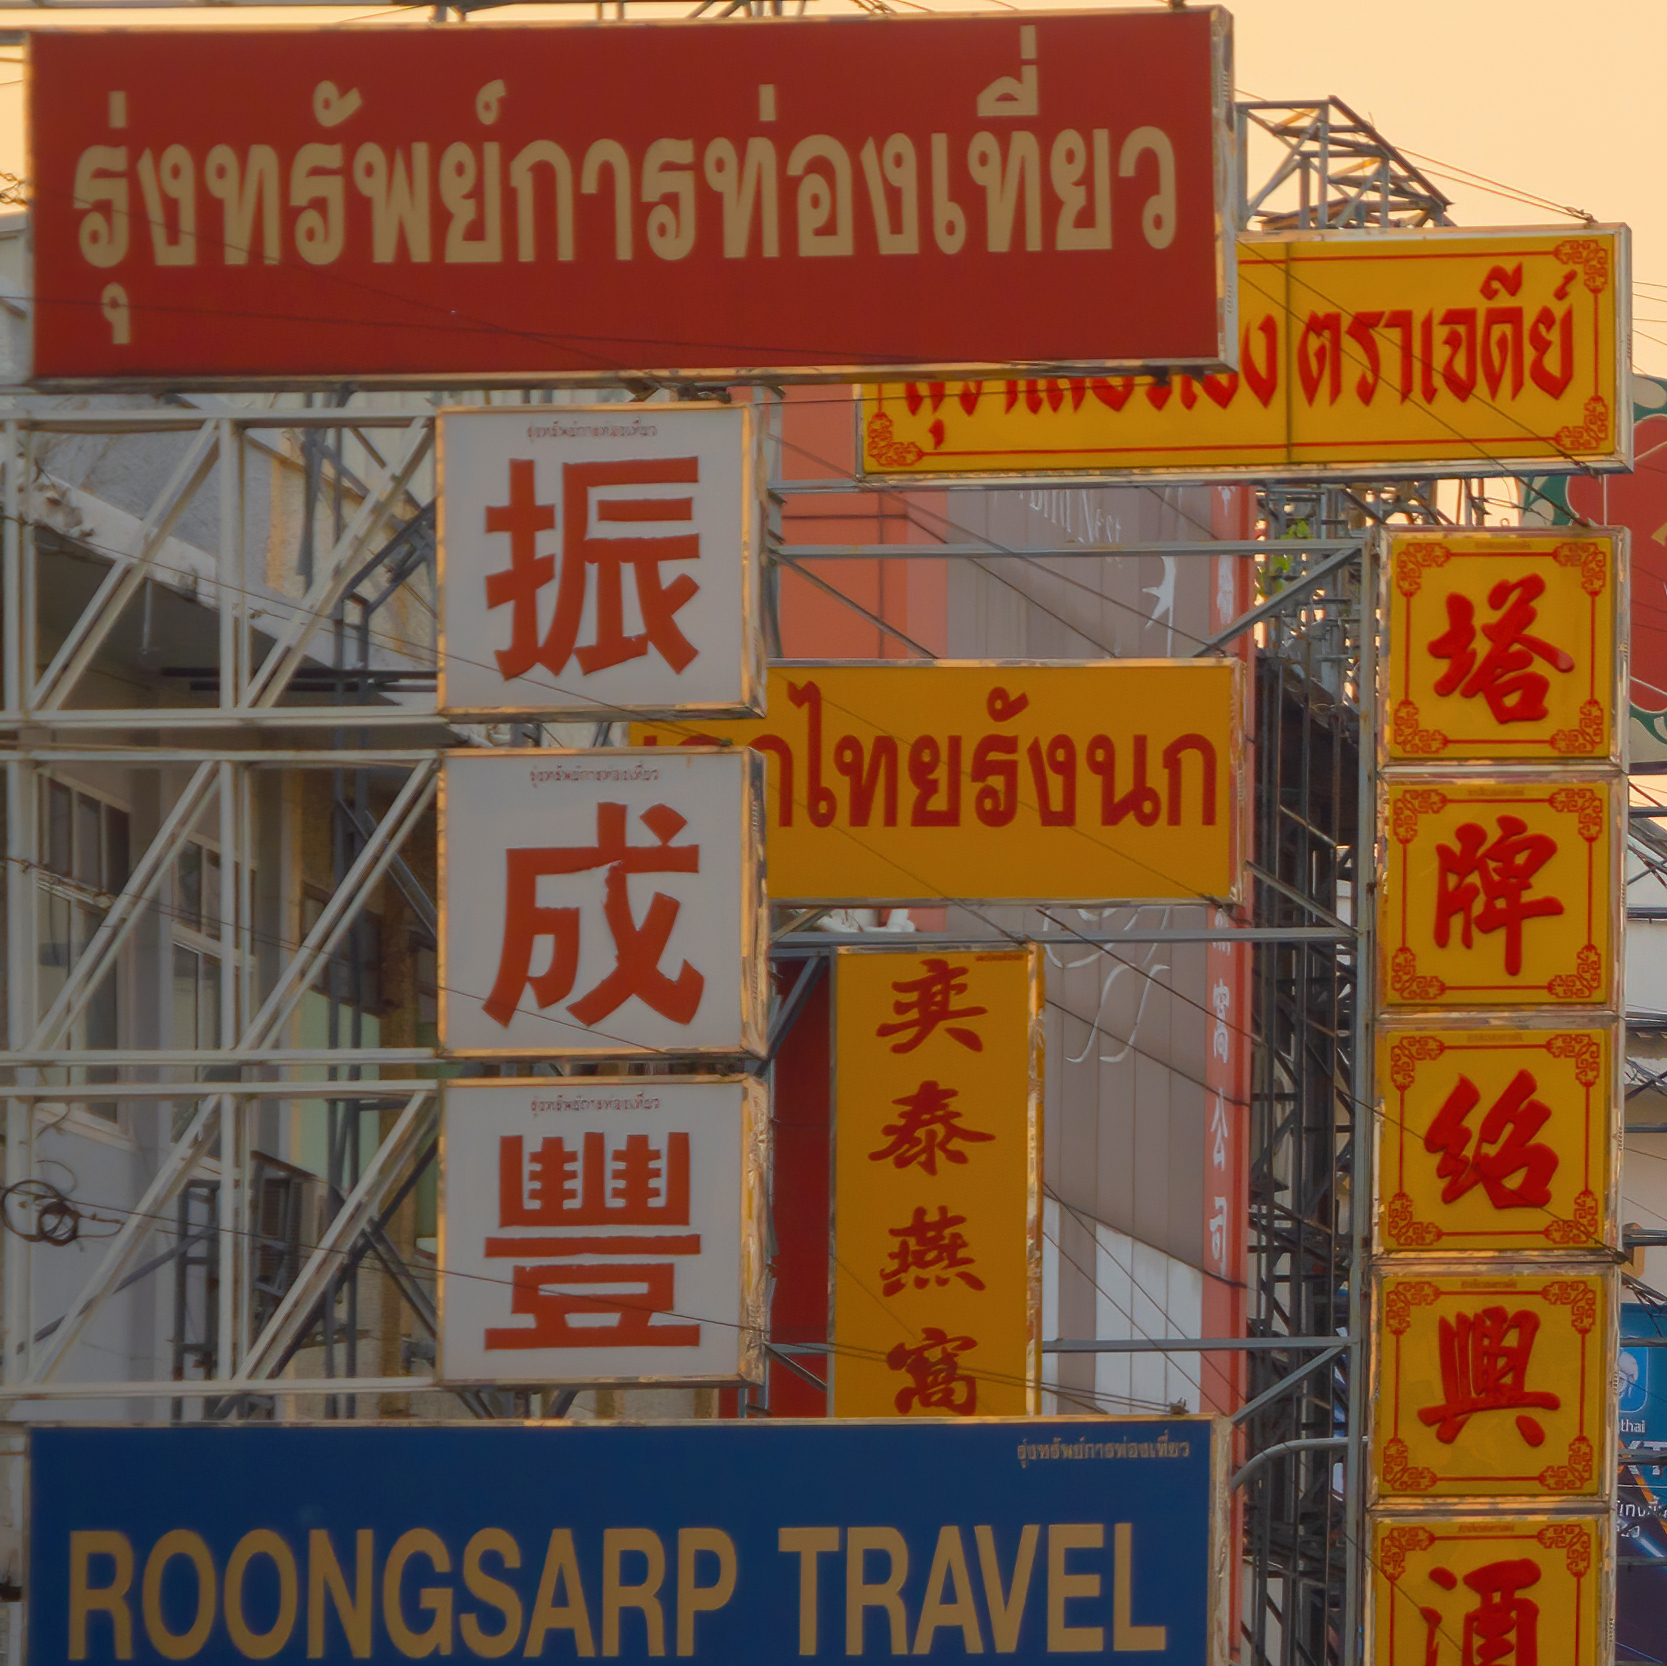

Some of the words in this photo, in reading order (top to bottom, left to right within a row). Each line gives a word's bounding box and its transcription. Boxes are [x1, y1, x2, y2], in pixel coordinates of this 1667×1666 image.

[74, 25, 1178, 345] รุ่งทรัพย์การท่องเที่ยว
[67, 1528, 738, 1662] ROONGSARP
[777, 1522, 1167, 1655] TRAVEL
